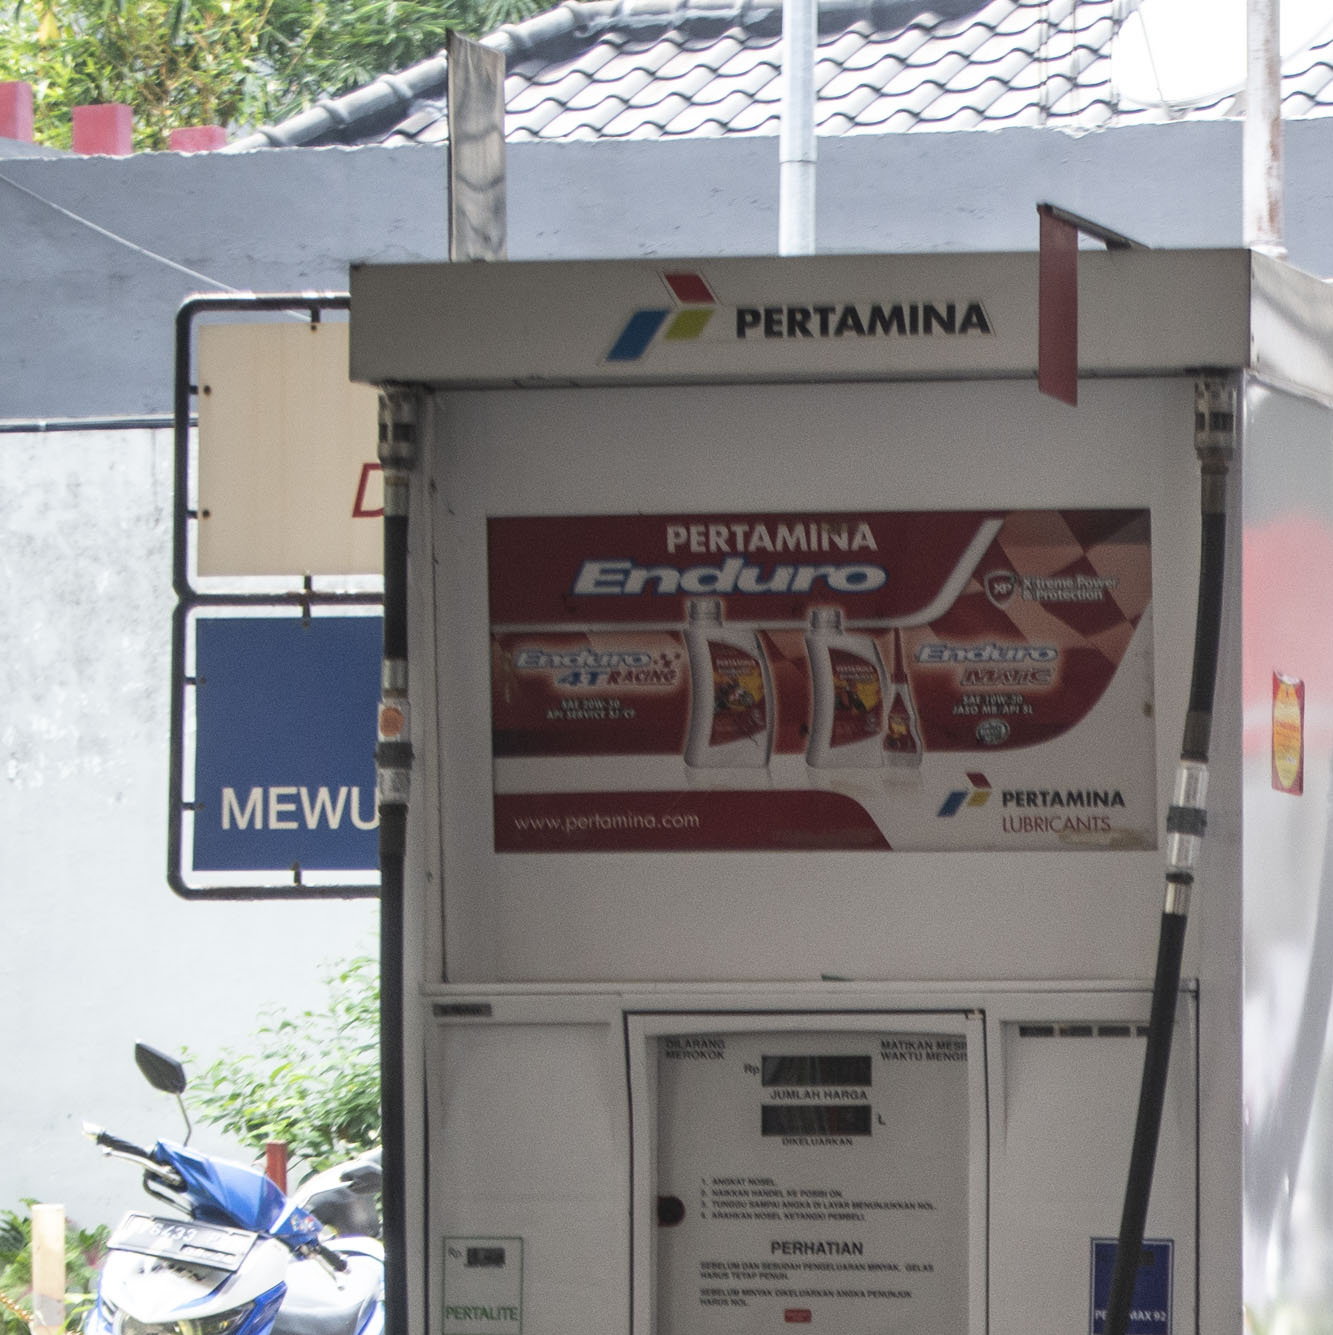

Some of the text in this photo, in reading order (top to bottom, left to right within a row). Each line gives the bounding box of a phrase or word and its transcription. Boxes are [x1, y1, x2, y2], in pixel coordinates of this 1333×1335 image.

[736, 302, 991, 338] PERTAMINA
[667, 521, 878, 553] PERTAMINA
[571, 555, 887, 596] Enduro
[916, 643, 1058, 664] Enduro
[607, 670, 676, 685] RACING
[1002, 789, 1126, 808] PERTAMINA
[514, 811, 700, 833] www.pertamina.com
[1002, 815, 1111, 833] LUBRICANTS
[666, 1040, 726, 1050] DILARANG
[881, 1040, 933, 1050] MATIKAN
[666, 1050, 725, 1060] MEROKOK
[881, 1051, 923, 1061] WAKTU
[744, 1063, 760, 1076] Rp
[770, 1090, 868, 1101] JUMLAH HARGA
[770, 1241, 864, 1257] PERHATIAN
[446, 1305, 519, 1321] PERTALITE
